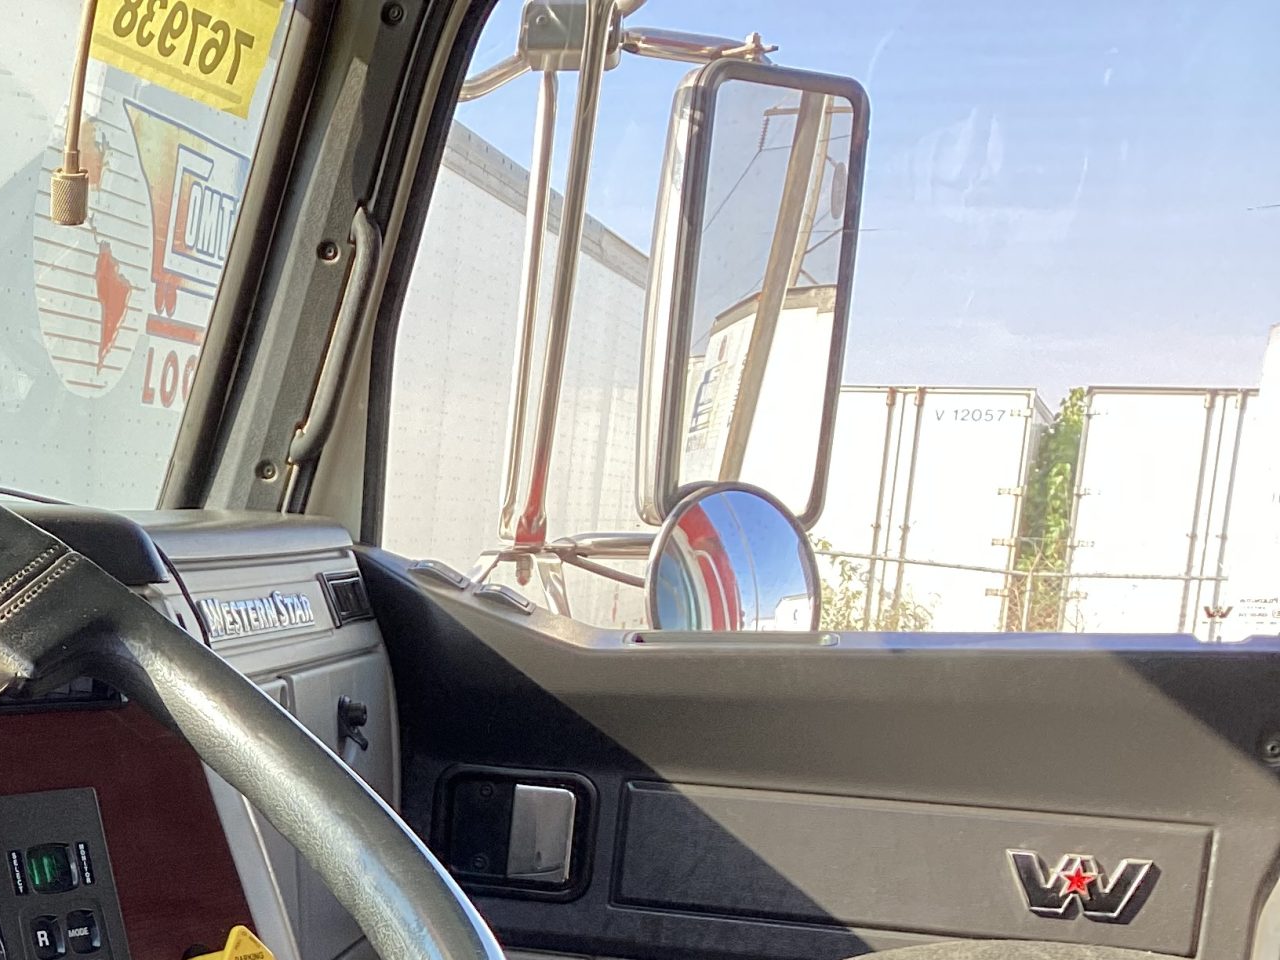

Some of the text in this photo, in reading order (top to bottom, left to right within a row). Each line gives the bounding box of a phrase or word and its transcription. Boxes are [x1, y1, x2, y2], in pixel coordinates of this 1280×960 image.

[953, 408, 1006, 422] 12057
[36, 930, 50, 947] R
[68, 927, 90, 938] MODE
